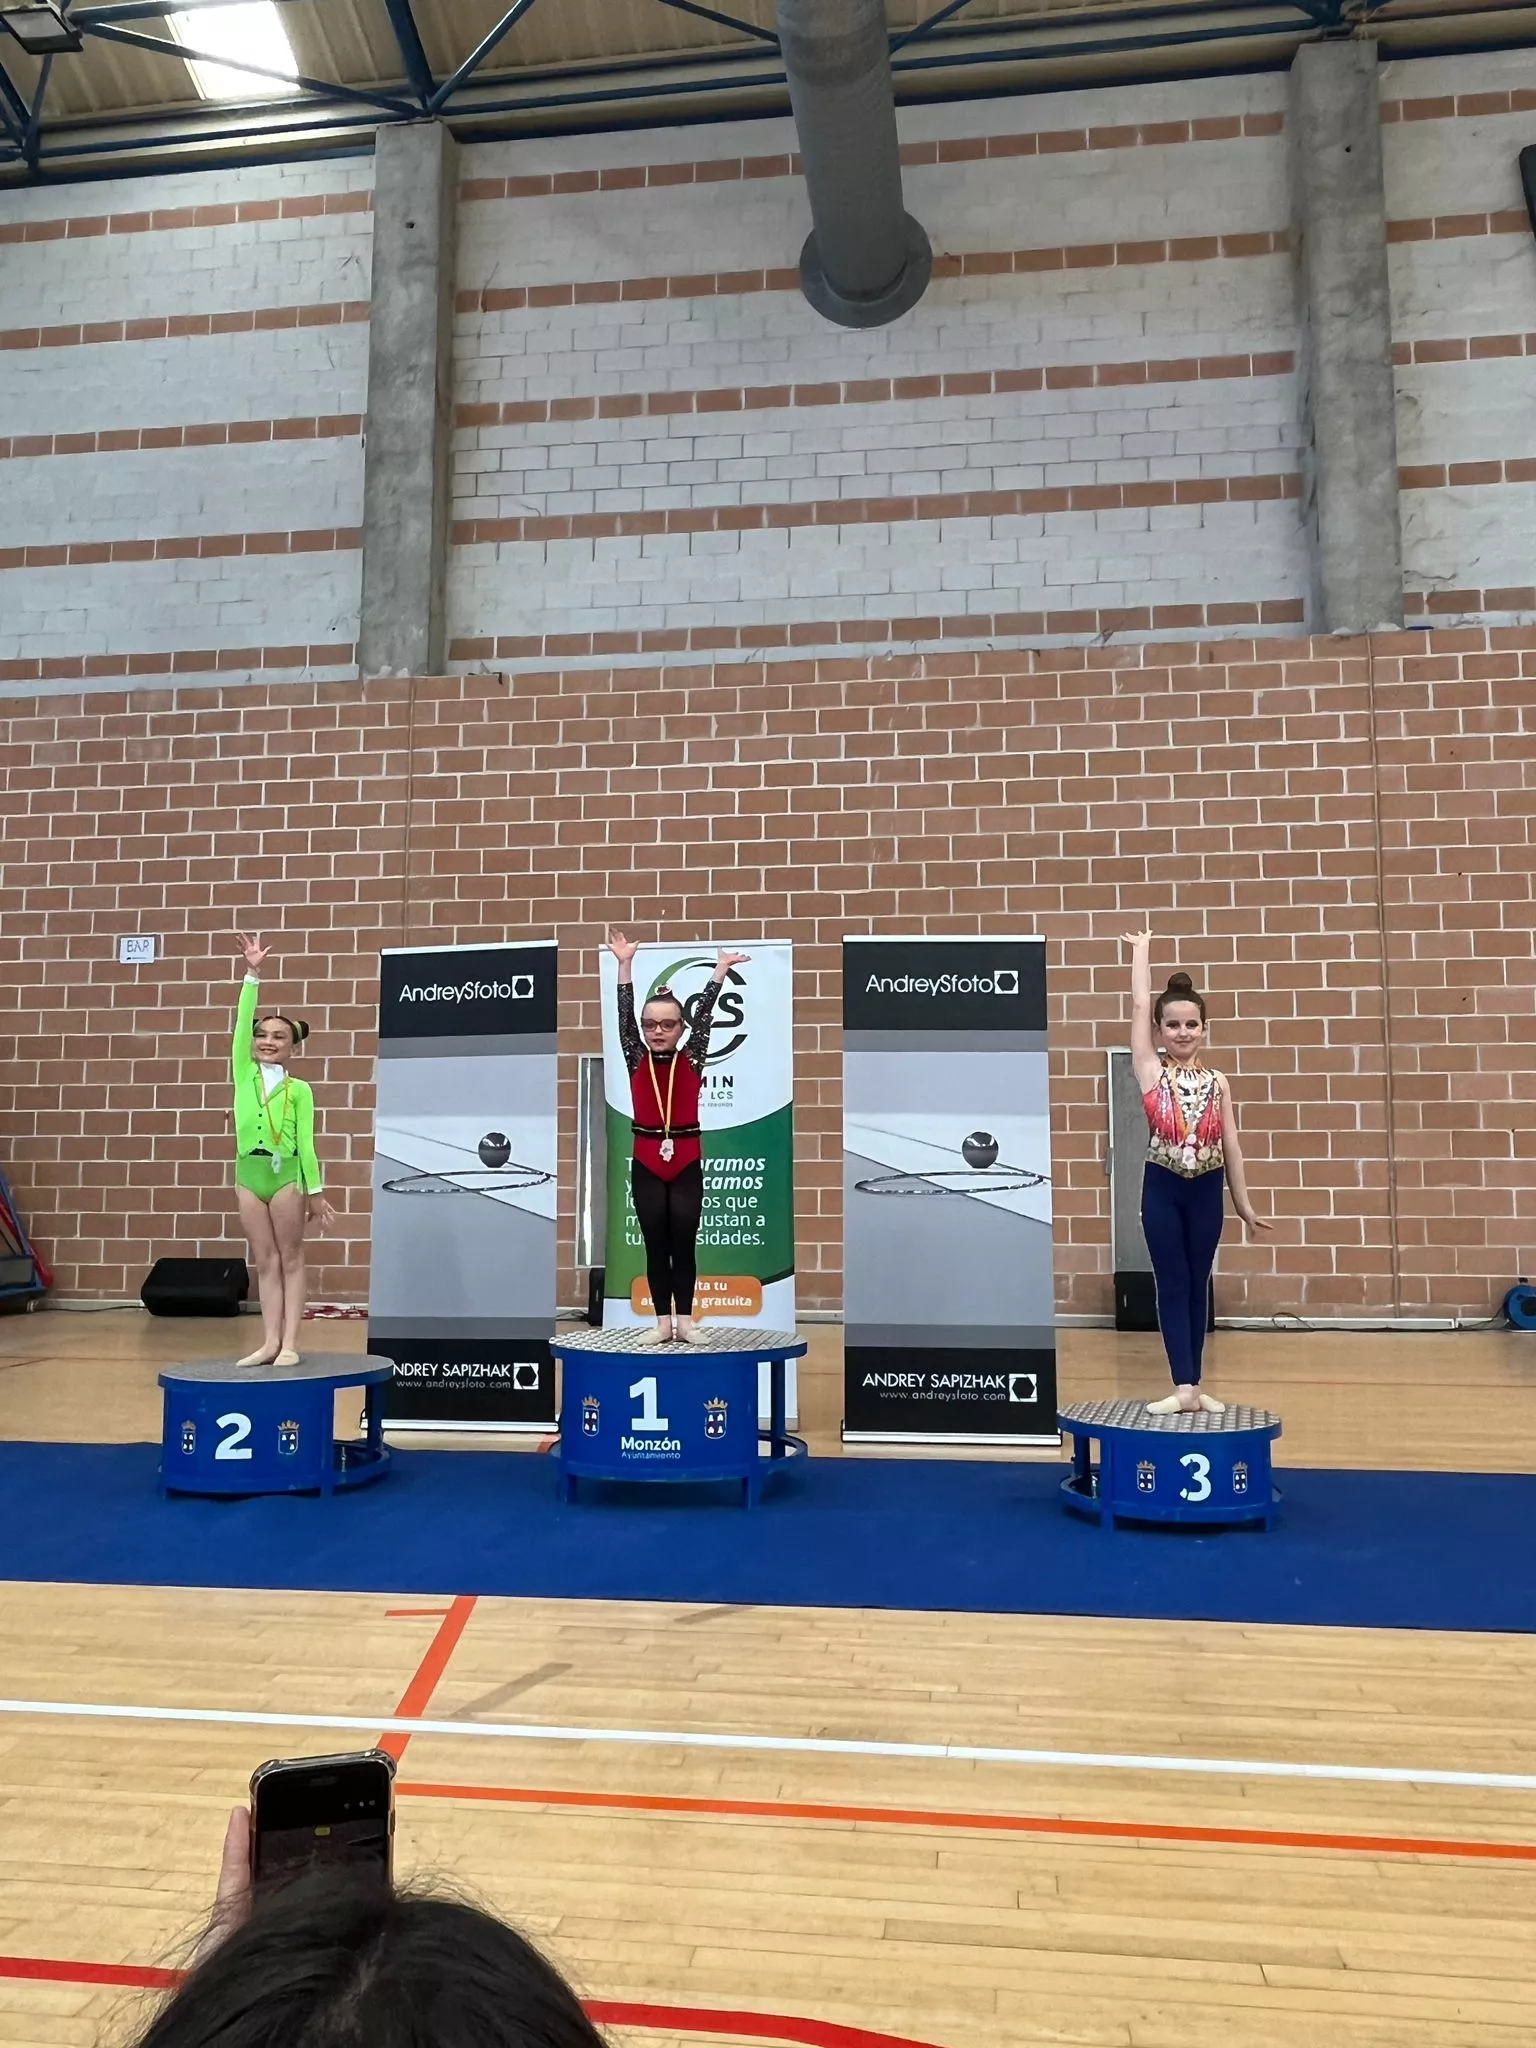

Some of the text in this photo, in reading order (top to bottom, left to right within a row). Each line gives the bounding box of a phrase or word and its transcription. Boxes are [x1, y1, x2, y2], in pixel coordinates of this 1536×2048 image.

[399, 981, 511, 1004] AndreySfoto
[866, 974, 994, 997] AndreySfoto
[699, 1076, 733, 1088] MIN
[711, 1091, 733, 1100] LCS
[700, 1157, 766, 1171] ramos
[702, 1176, 763, 1189] camos
[726, 1196, 757, 1211] que
[698, 1213, 766, 1231] justan a
[696, 1230, 766, 1246] sidades.
[714, 1281, 728, 1291] tu
[701, 1294, 752, 1308] gratuita
[393, 1362, 510, 1378] NDREY SAPIZHAK
[862, 1373, 1006, 1389] ANDREY SAPIZHAK
[629, 1376, 669, 1431] 1
[215, 1412, 252, 1460] 2
[621, 1436, 681, 1451] Monzón
[1179, 1453, 1212, 1502] 3
